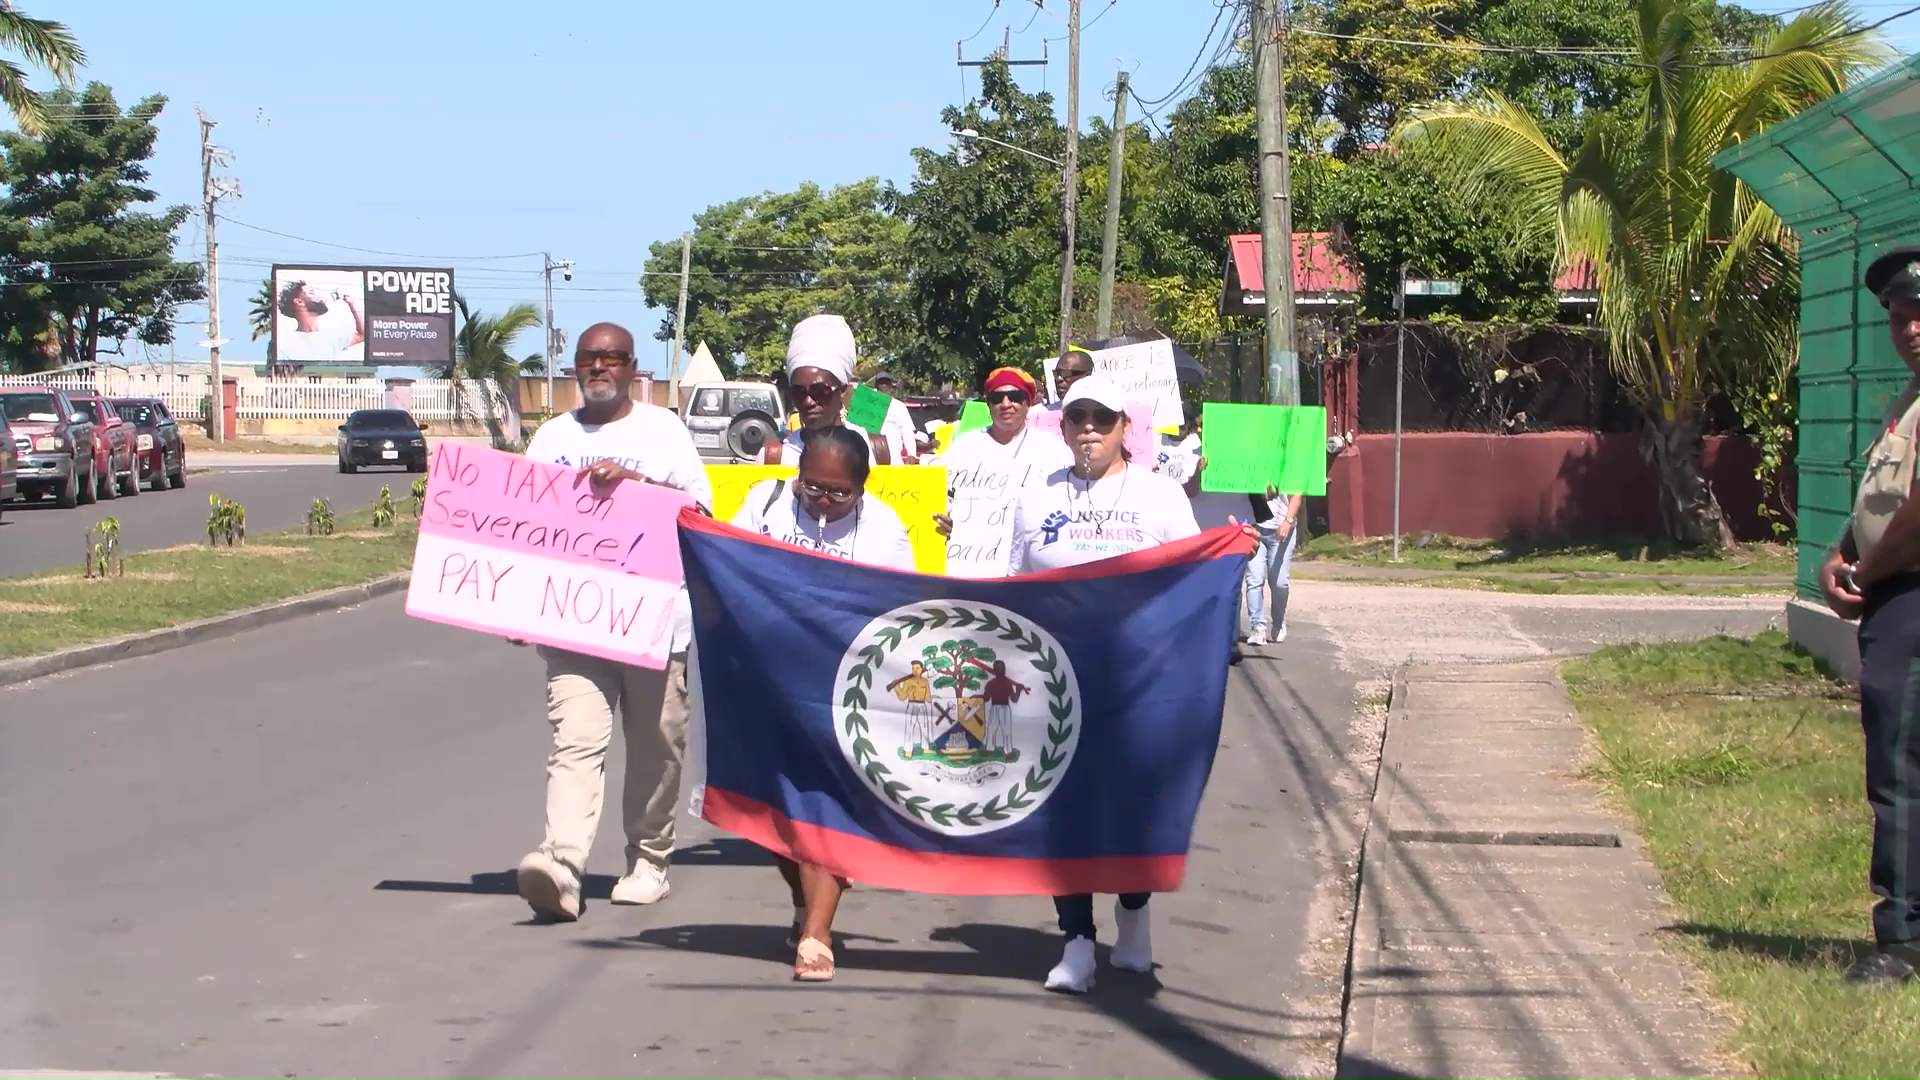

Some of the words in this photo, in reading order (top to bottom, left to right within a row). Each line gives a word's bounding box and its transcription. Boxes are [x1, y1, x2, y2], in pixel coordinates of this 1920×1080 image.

[367, 271, 450, 293] POWER
[405, 292, 452, 314] ADE
[373, 320, 397, 330] More
[399, 320, 429, 330] Power
[383, 330, 409, 341] Every
[410, 330, 438, 339] Pause
[434, 443, 480, 487] No
[504, 459, 565, 505] TAX
[576, 493, 614, 521] on
[1077, 509, 1141, 525] JUSTICE
[427, 490, 645, 567] Severance!
[1069, 527, 1144, 542] WORKERS
[439, 552, 515, 602] PAY
